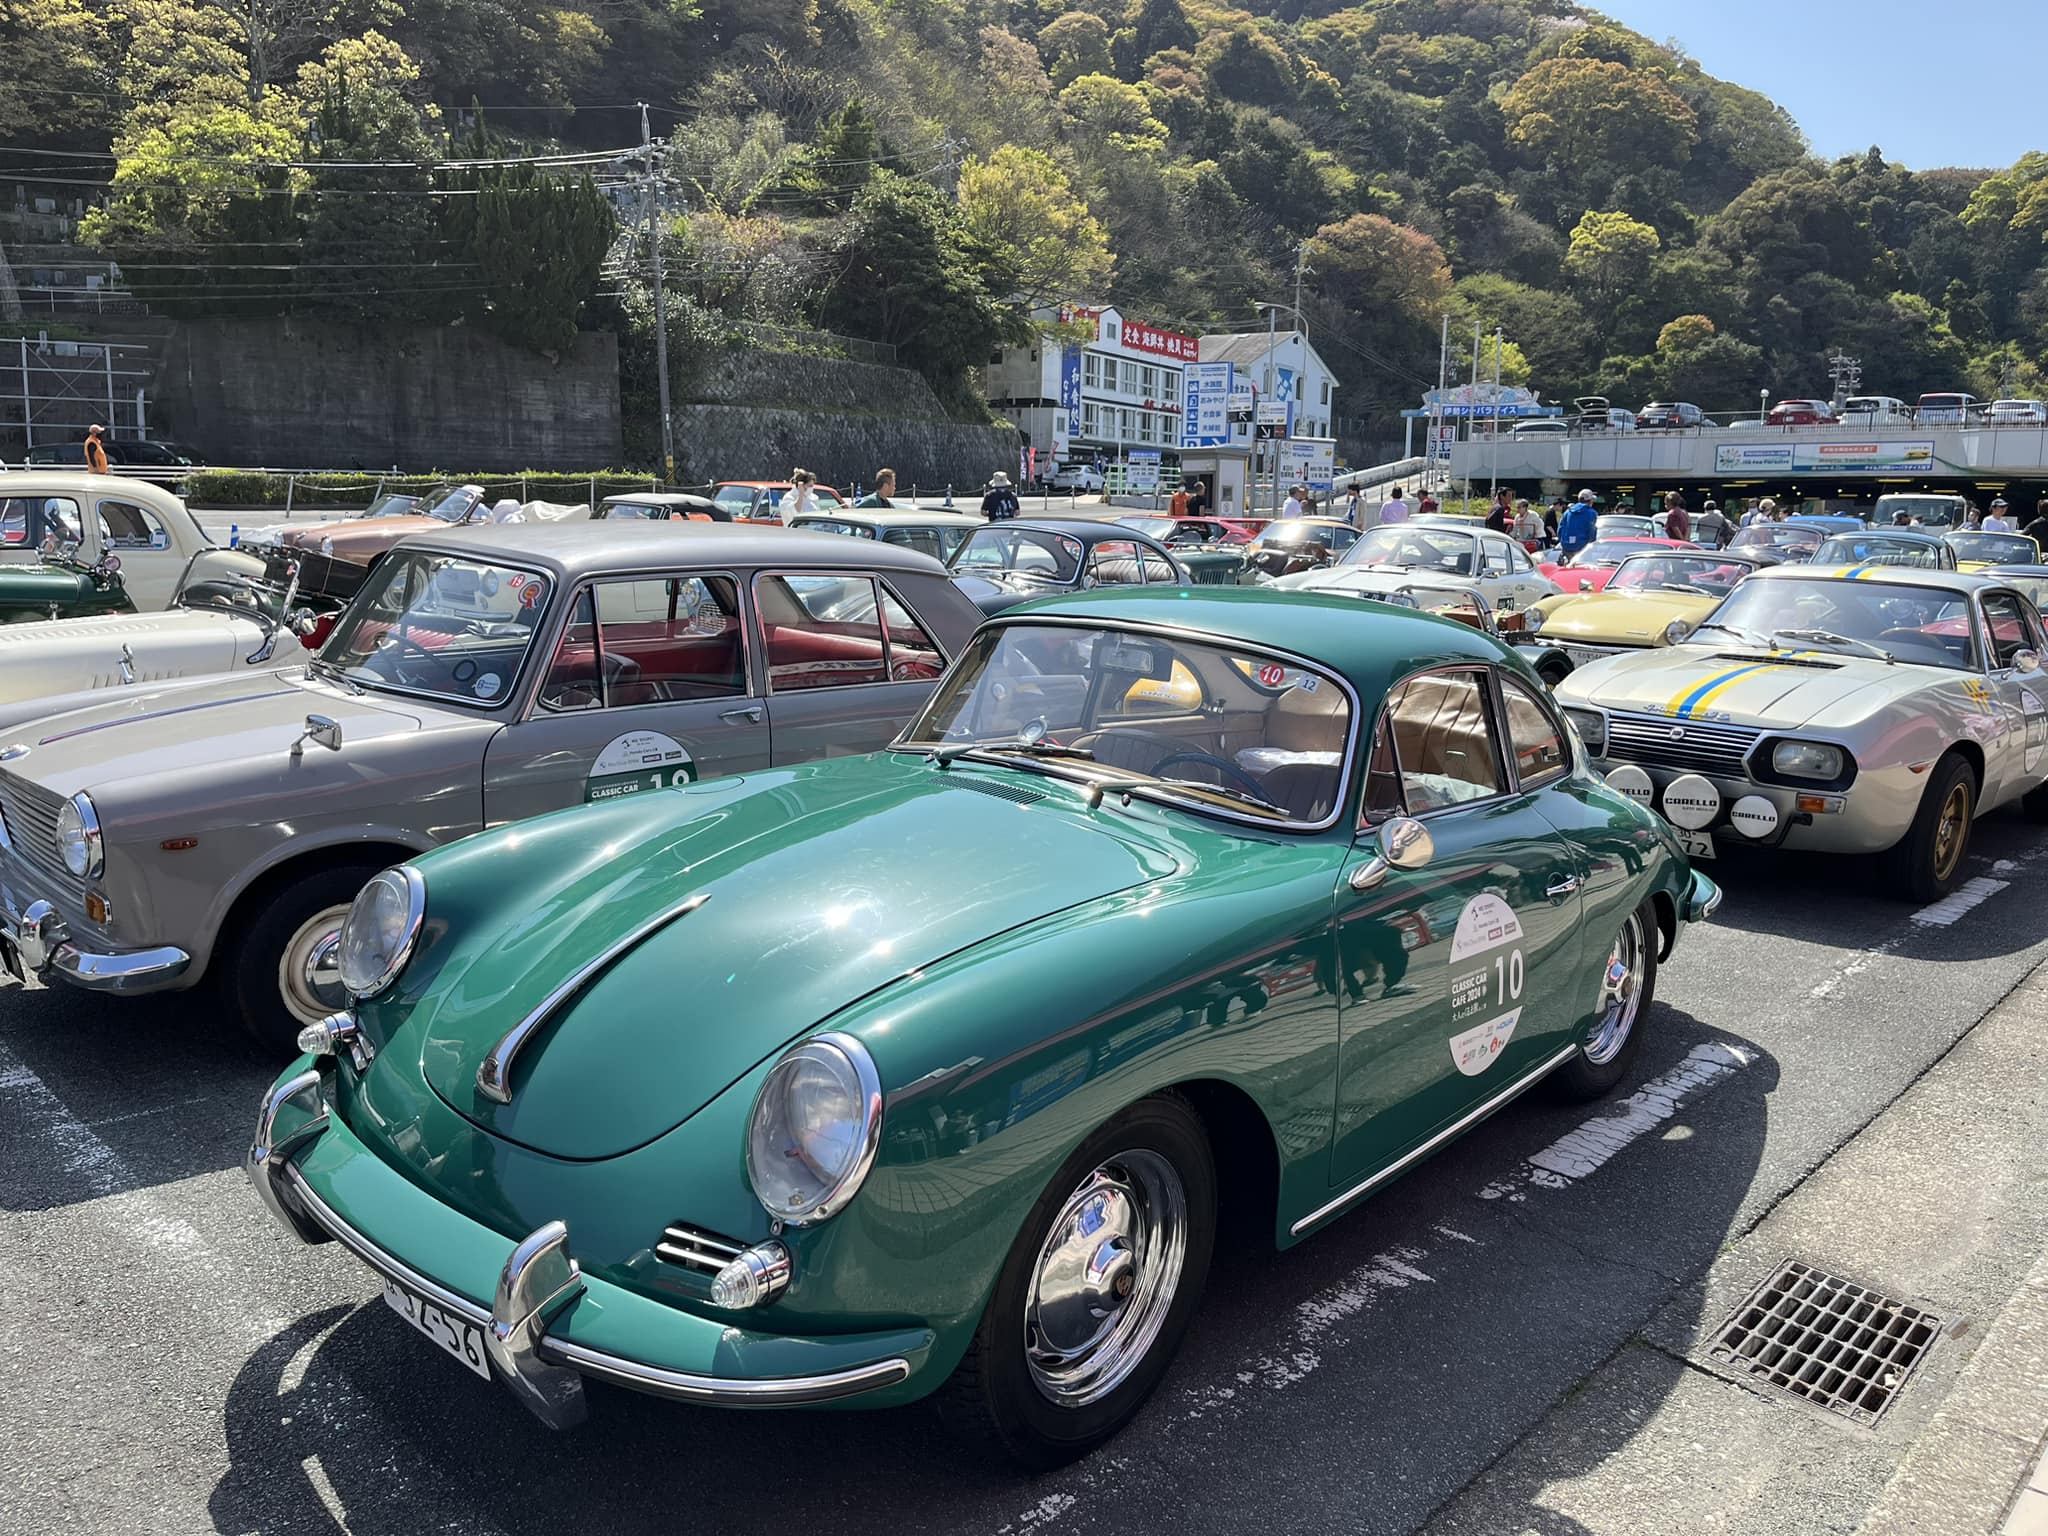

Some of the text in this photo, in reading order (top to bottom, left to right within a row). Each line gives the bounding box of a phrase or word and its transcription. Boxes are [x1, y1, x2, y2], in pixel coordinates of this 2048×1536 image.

[1263, 666, 1281, 683] 10
[1304, 680, 1316, 691] 12
[592, 786, 621, 798] CLASSIC
[623, 784, 639, 794] CAR
[1665, 797, 1718, 807] CARELLO
[1731, 811, 1776, 823] CARELLO
[1452, 977, 1475, 995] CLASSIC
[1475, 972, 1488, 986] CAR
[1495, 948, 1524, 1005] 10
[1452, 985, 1481, 1009] CAFE 2024
